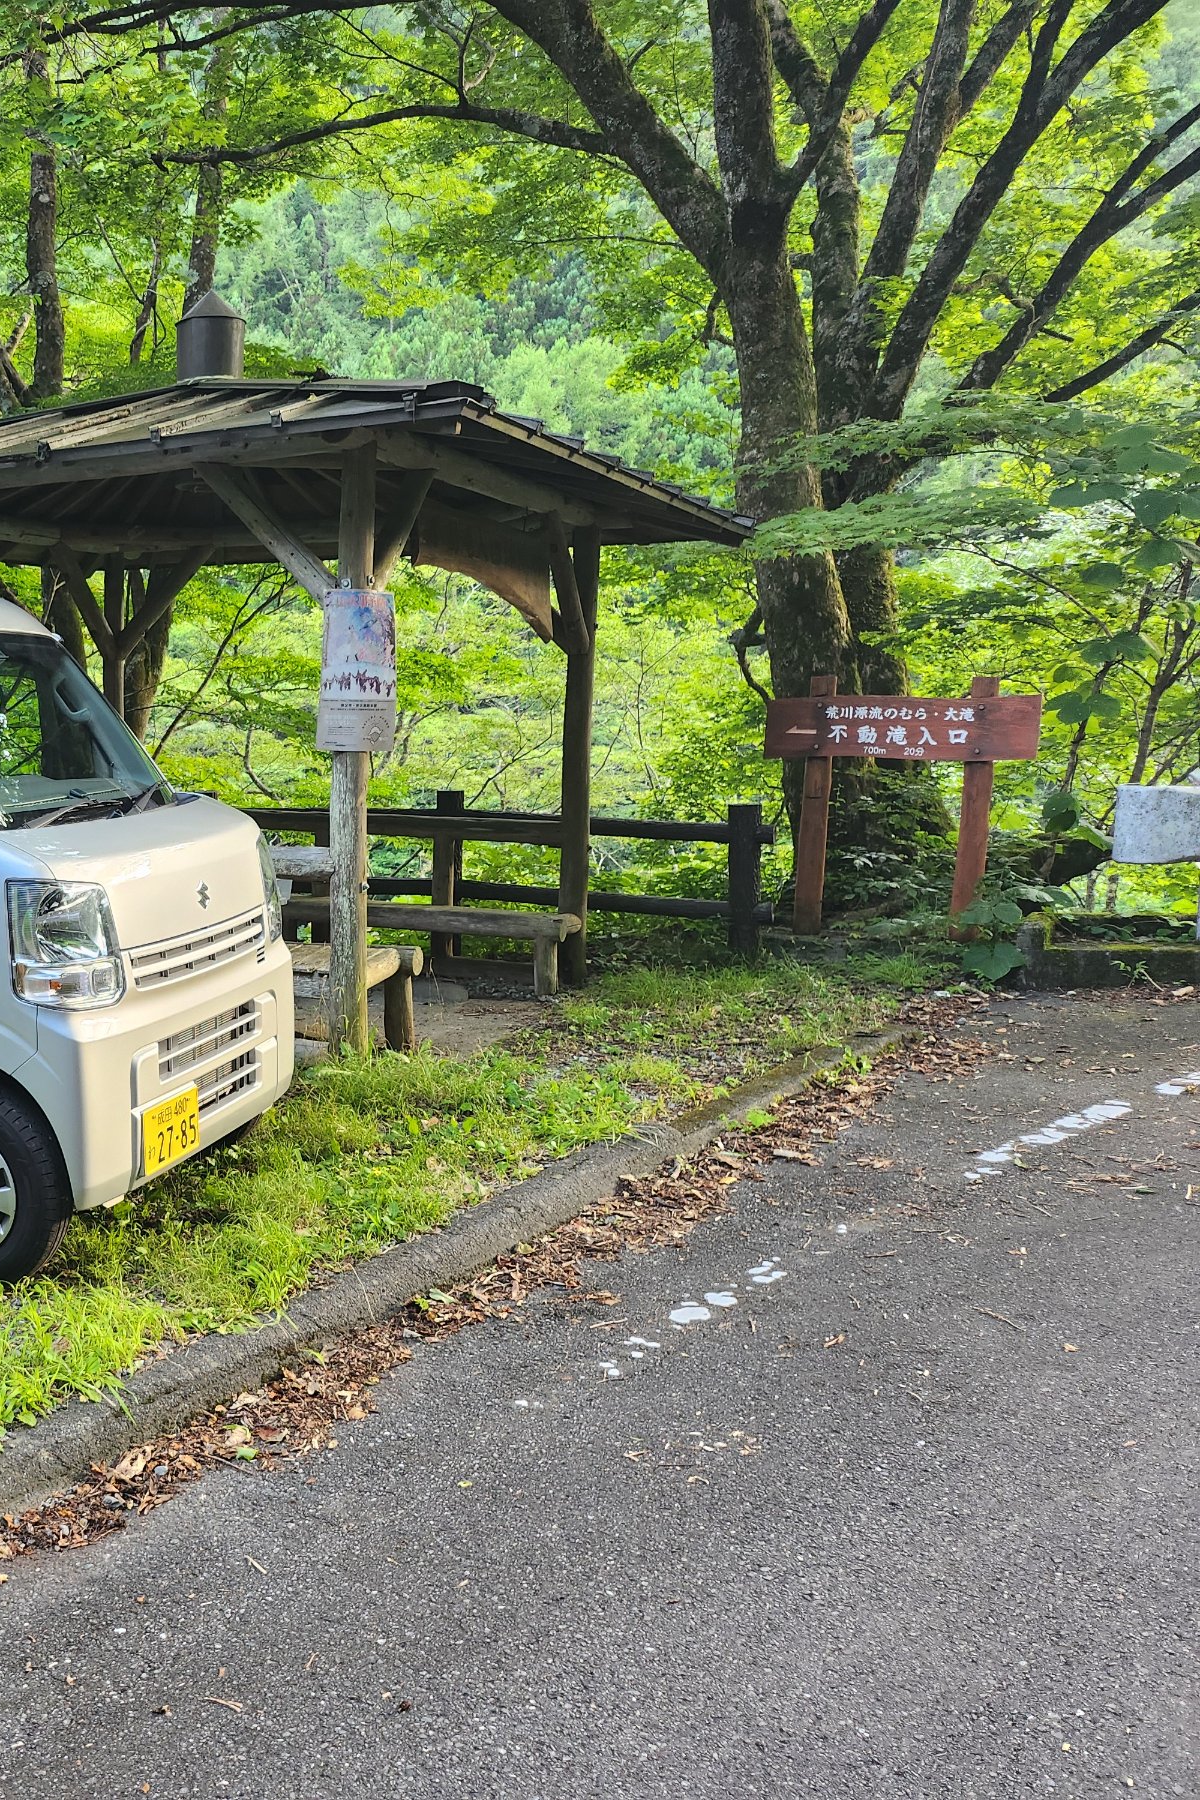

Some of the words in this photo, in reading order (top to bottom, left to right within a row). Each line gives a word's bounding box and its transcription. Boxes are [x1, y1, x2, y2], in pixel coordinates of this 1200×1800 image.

[825, 705, 976, 722] 荒川源流のむら・大滝
[827, 725, 969, 746] 不動滝入口
[863, 746, 887, 755] 700m
[904, 746, 925, 757] 20分
[174, 1097, 188, 1116] 480
